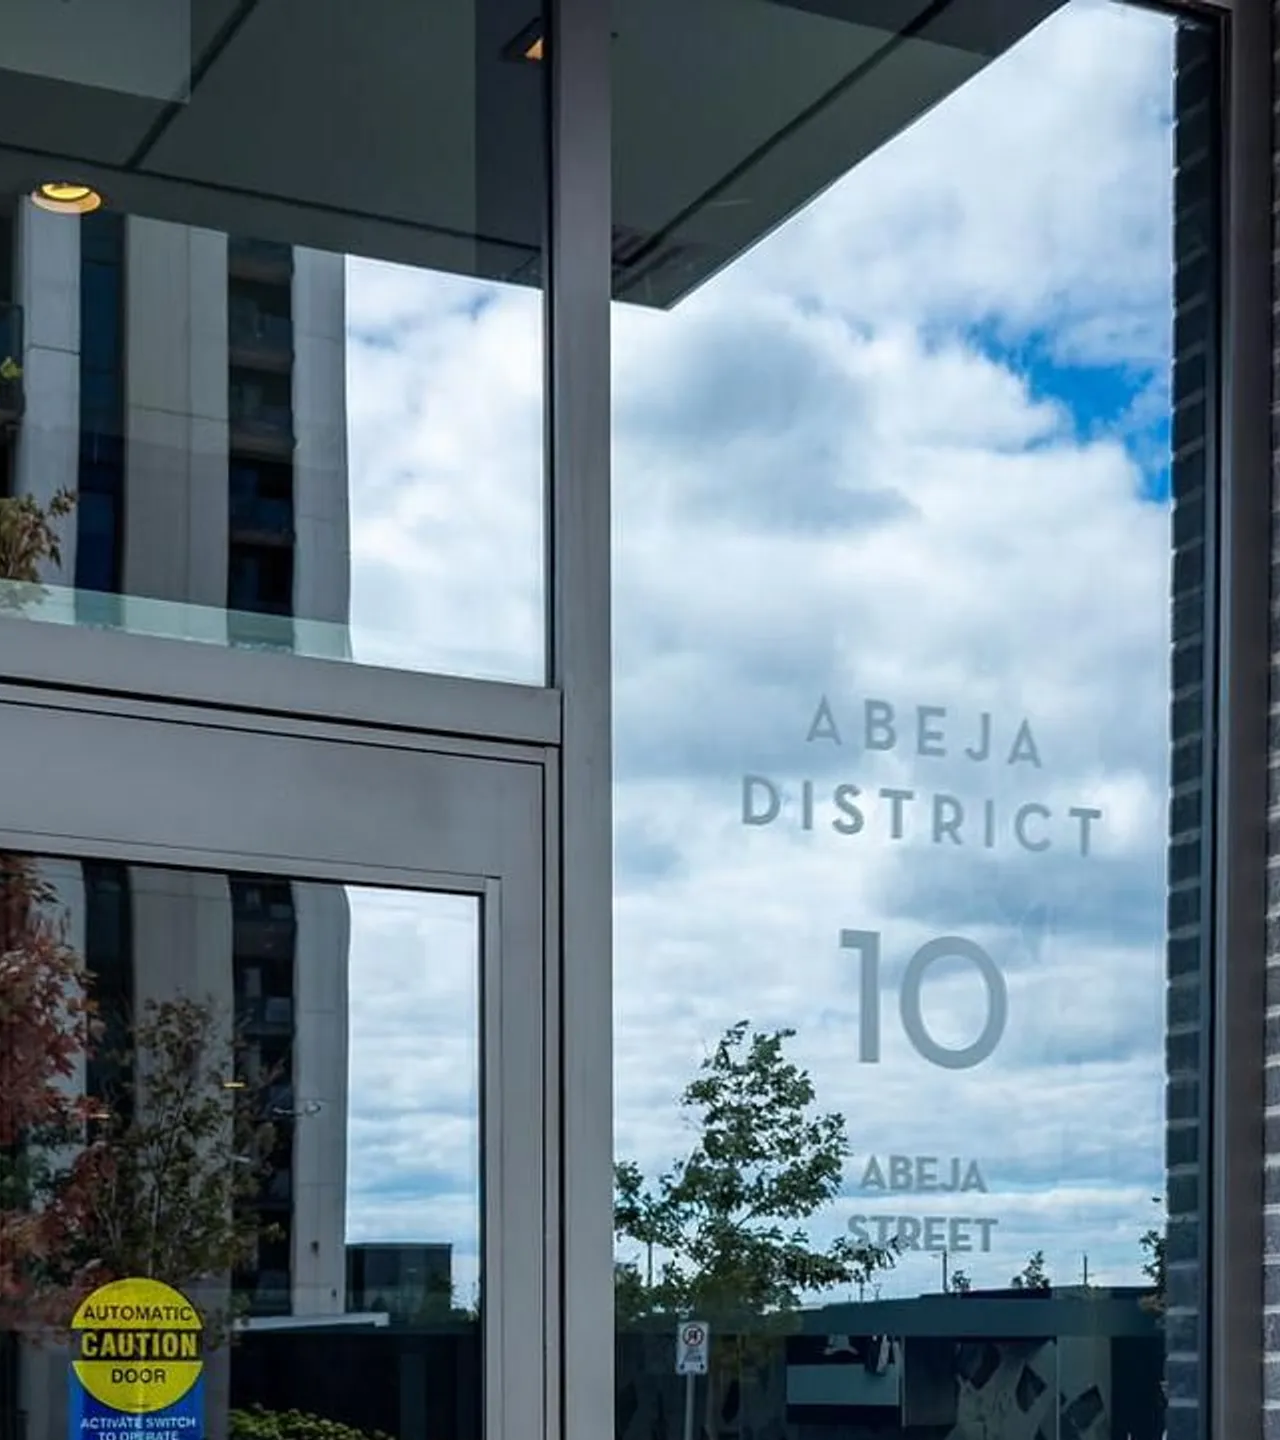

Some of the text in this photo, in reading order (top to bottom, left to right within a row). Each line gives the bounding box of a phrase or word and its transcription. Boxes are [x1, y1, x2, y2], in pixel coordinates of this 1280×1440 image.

[805, 694, 1042, 768] ABEJA
[741, 774, 1103, 858] DISTRICT
[839, 928, 1008, 1070] 10
[859, 1154, 987, 1193] ABEJA
[847, 1213, 999, 1253] STREET
[83, 1305, 193, 1321] AUTOMATIC
[81, 1331, 198, 1358] CAUTION
[112, 1368, 167, 1384] DOOR
[80, 1416, 196, 1429] ACTIVATE SWITCH
